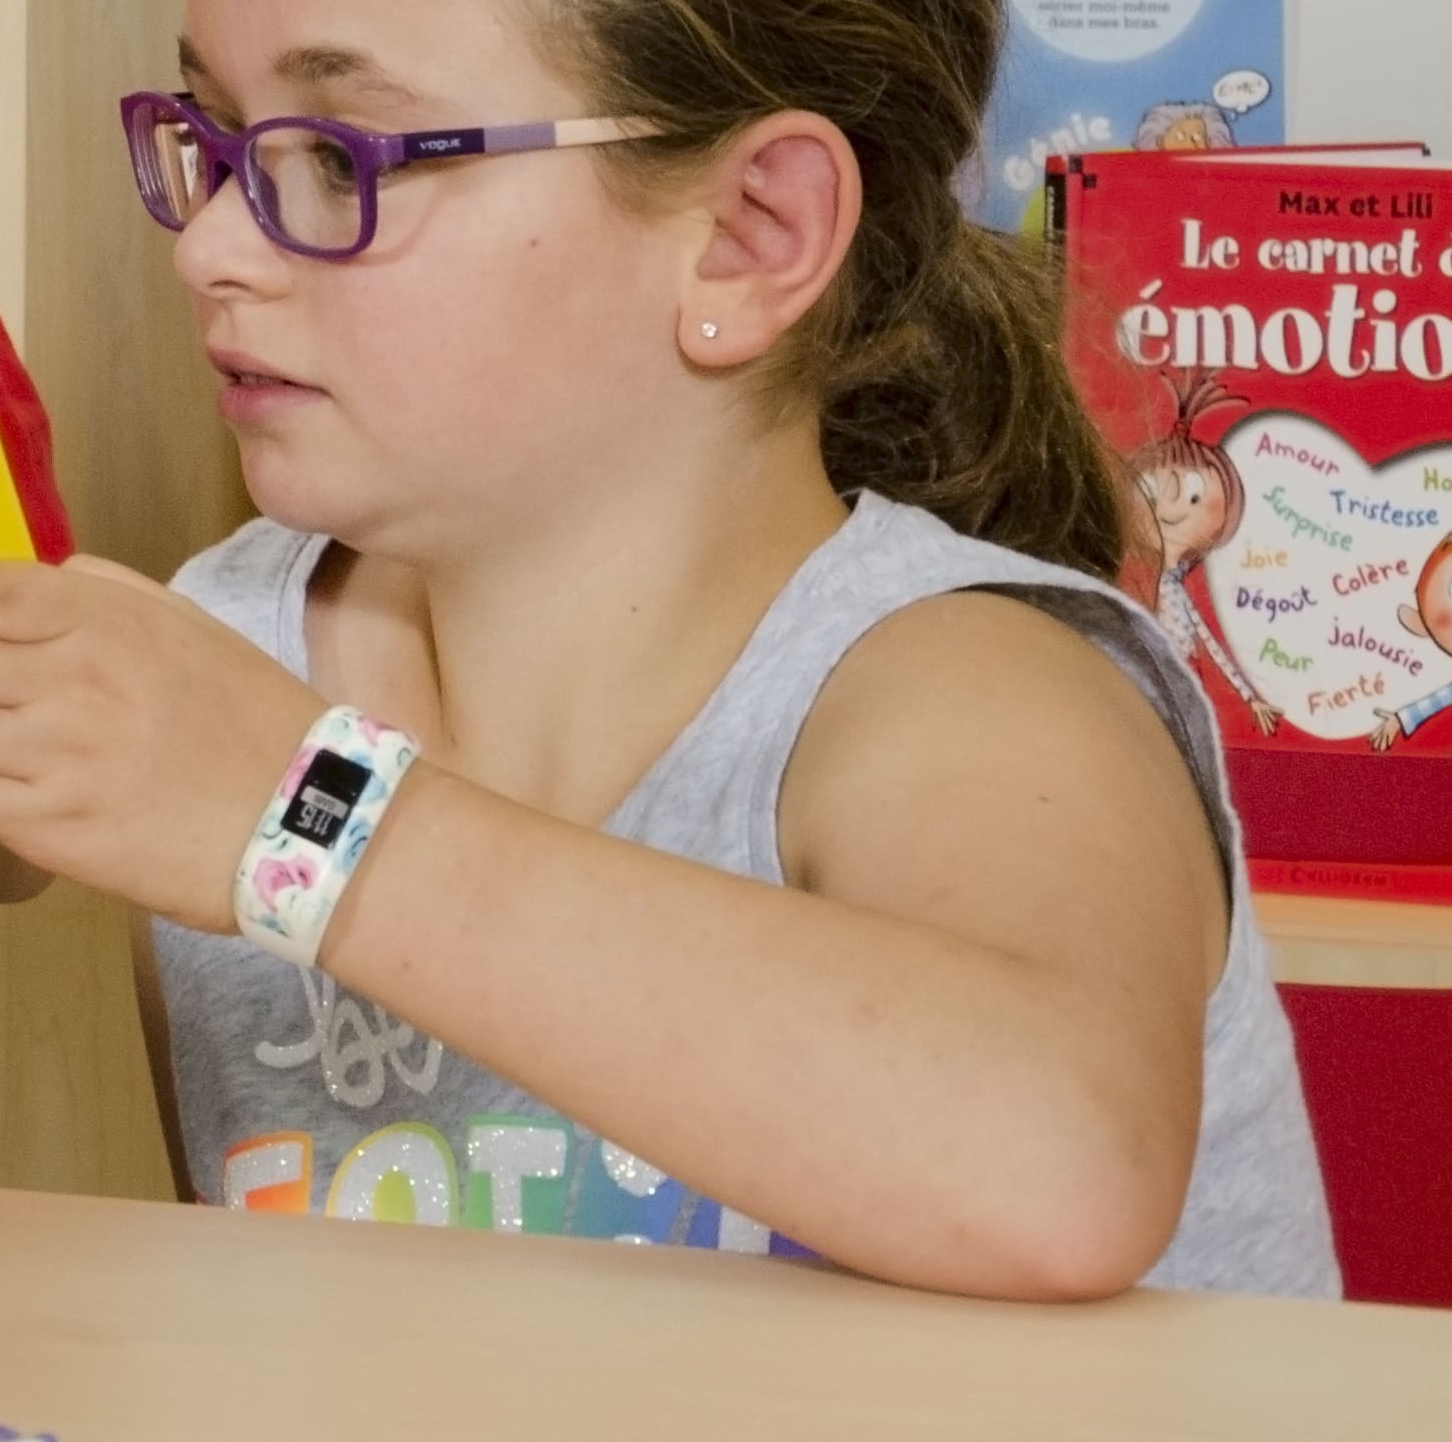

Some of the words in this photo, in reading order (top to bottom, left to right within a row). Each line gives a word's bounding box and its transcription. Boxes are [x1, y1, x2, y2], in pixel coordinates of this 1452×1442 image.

[1278, 190, 1339, 217] Max
[1350, 193, 1379, 218] et
[1390, 193, 1434, 220] Lili
[1179, 218, 1241, 270] Le
[1257, 228, 1422, 278] carnet
[1255, 431, 1340, 478] Amour
[1262, 485, 1354, 553] Surprise
[1328, 489, 1439, 528] Tristesse
[1332, 557, 1411, 597] Colère
[1235, 585, 1319, 624] Dégoût
[1260, 638, 1314, 674] Peur
[1306, 675, 1387, 717] Fierté
